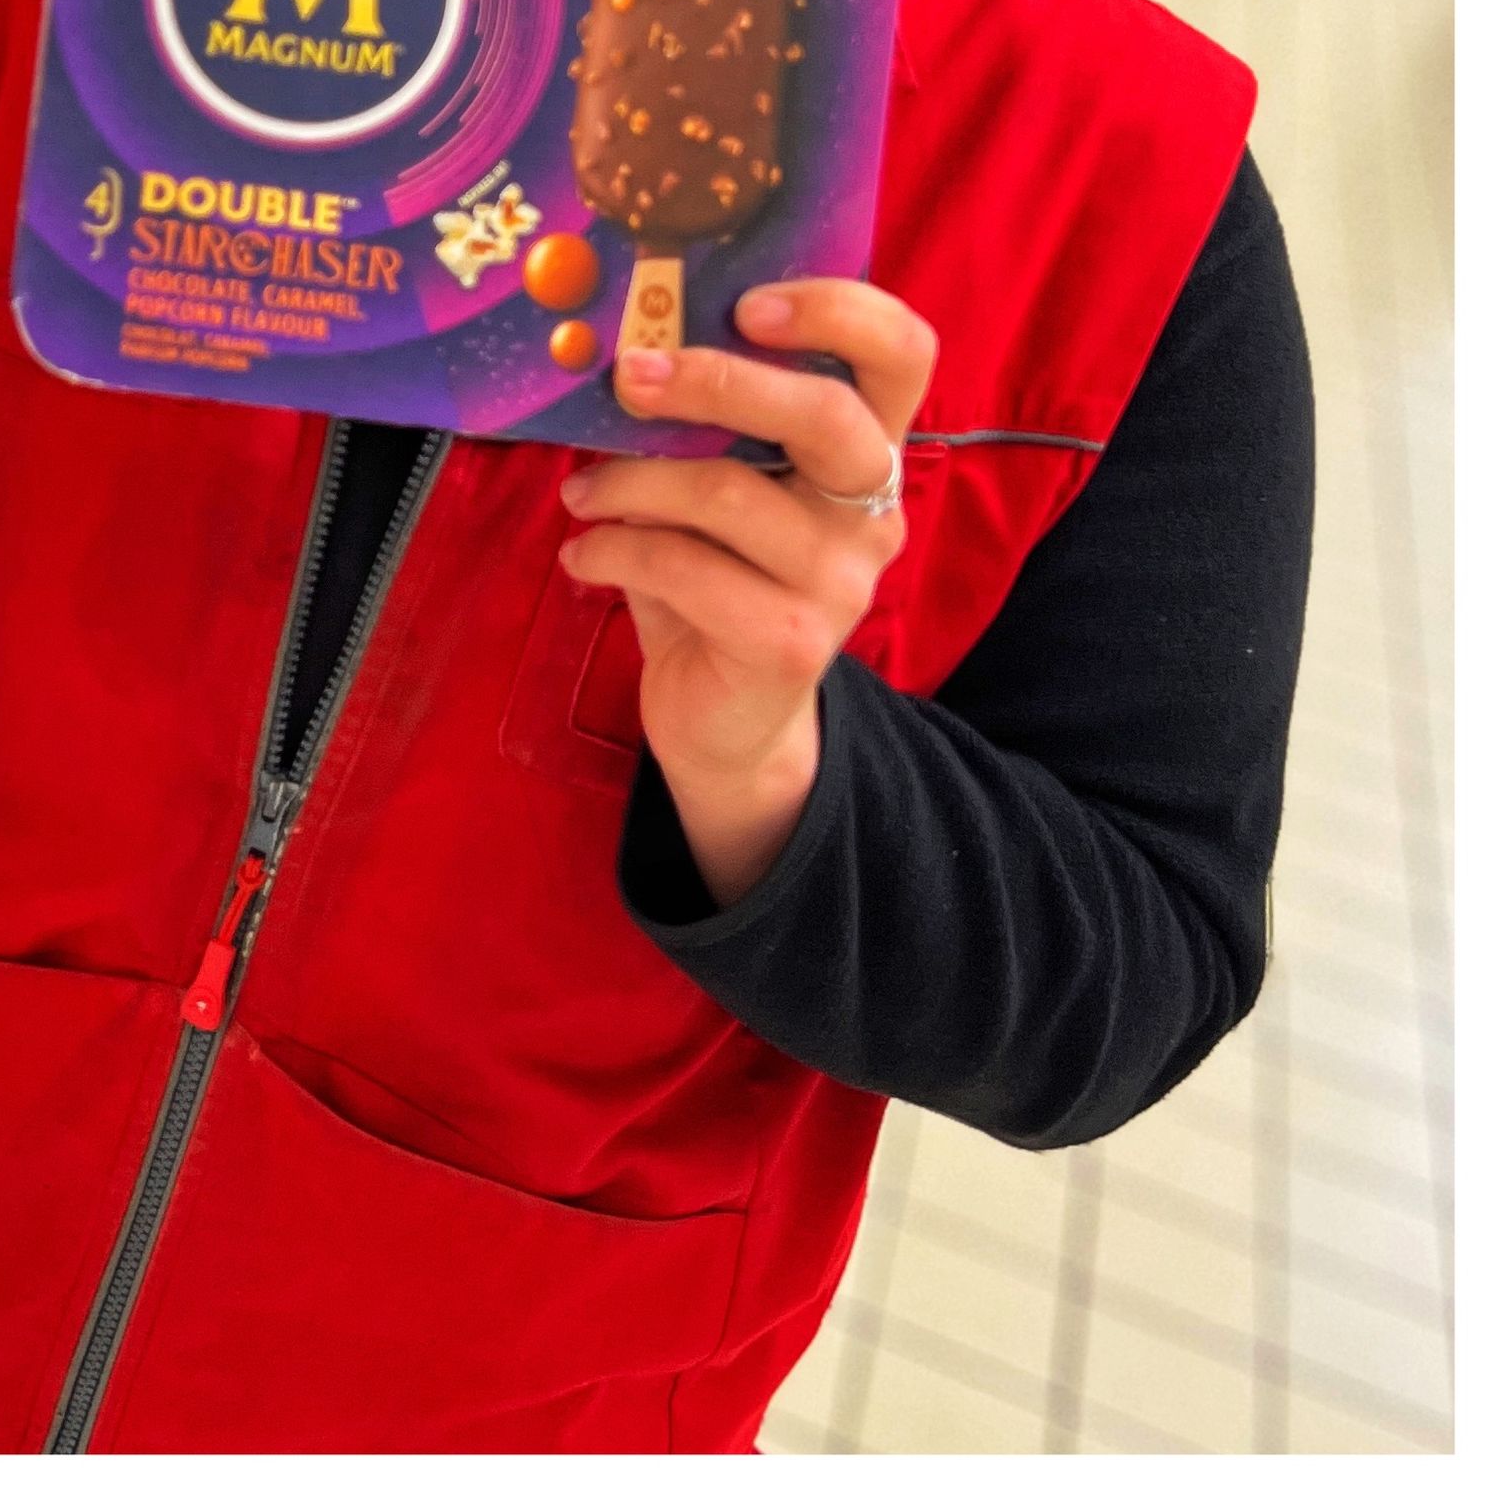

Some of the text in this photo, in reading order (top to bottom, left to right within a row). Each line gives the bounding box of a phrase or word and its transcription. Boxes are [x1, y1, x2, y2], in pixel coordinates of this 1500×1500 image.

[205, 19, 396, 78] MAGNUM
[84, 182, 108, 217] 4
[127, 217, 403, 294] STARCHASER
